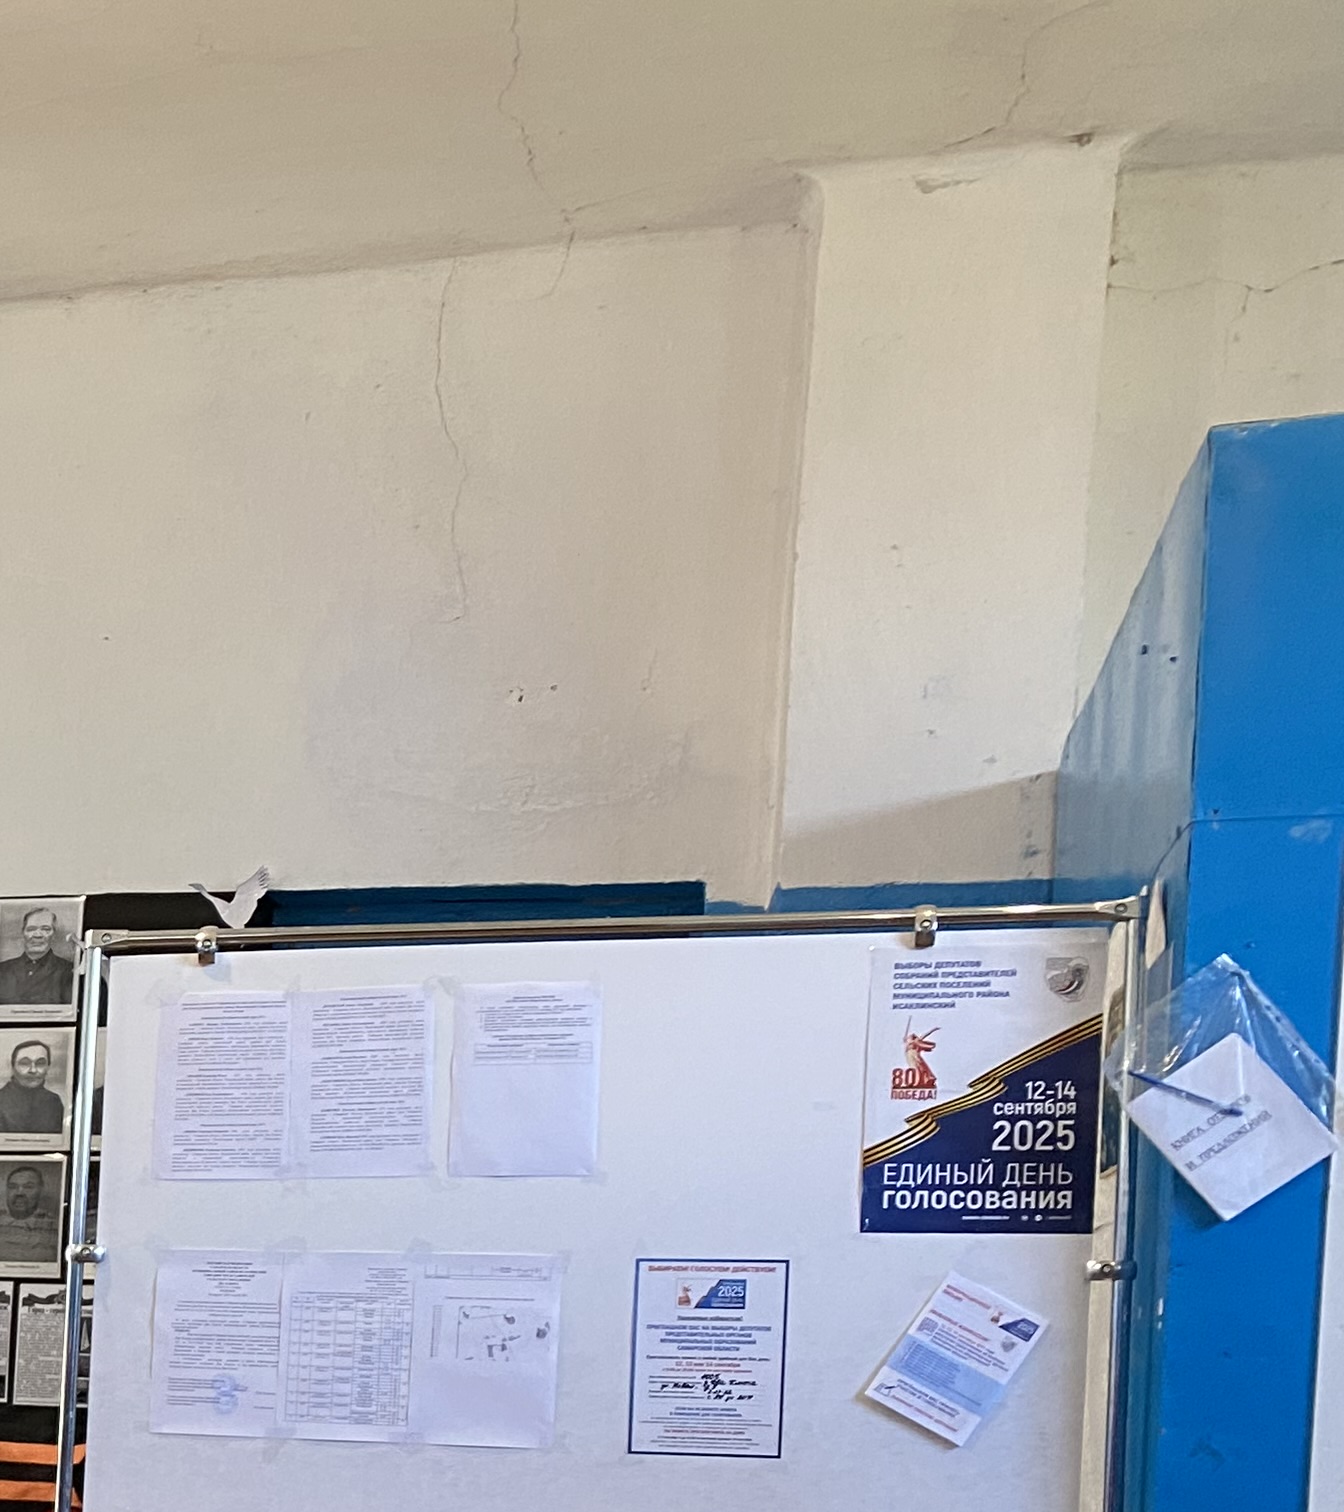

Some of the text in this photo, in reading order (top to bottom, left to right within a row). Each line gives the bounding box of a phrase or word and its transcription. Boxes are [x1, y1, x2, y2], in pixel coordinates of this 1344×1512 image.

[1025, 1081, 1077, 1100] 12-14
[993, 1100, 1077, 1118] сентября
[991, 1119, 1076, 1152] 2025
[883, 1159, 1073, 1188] ЕДИНЫЙ ДЕНЬ
[882, 1190, 1073, 1210] голосования
[717, 1286, 744, 1298] 2025
